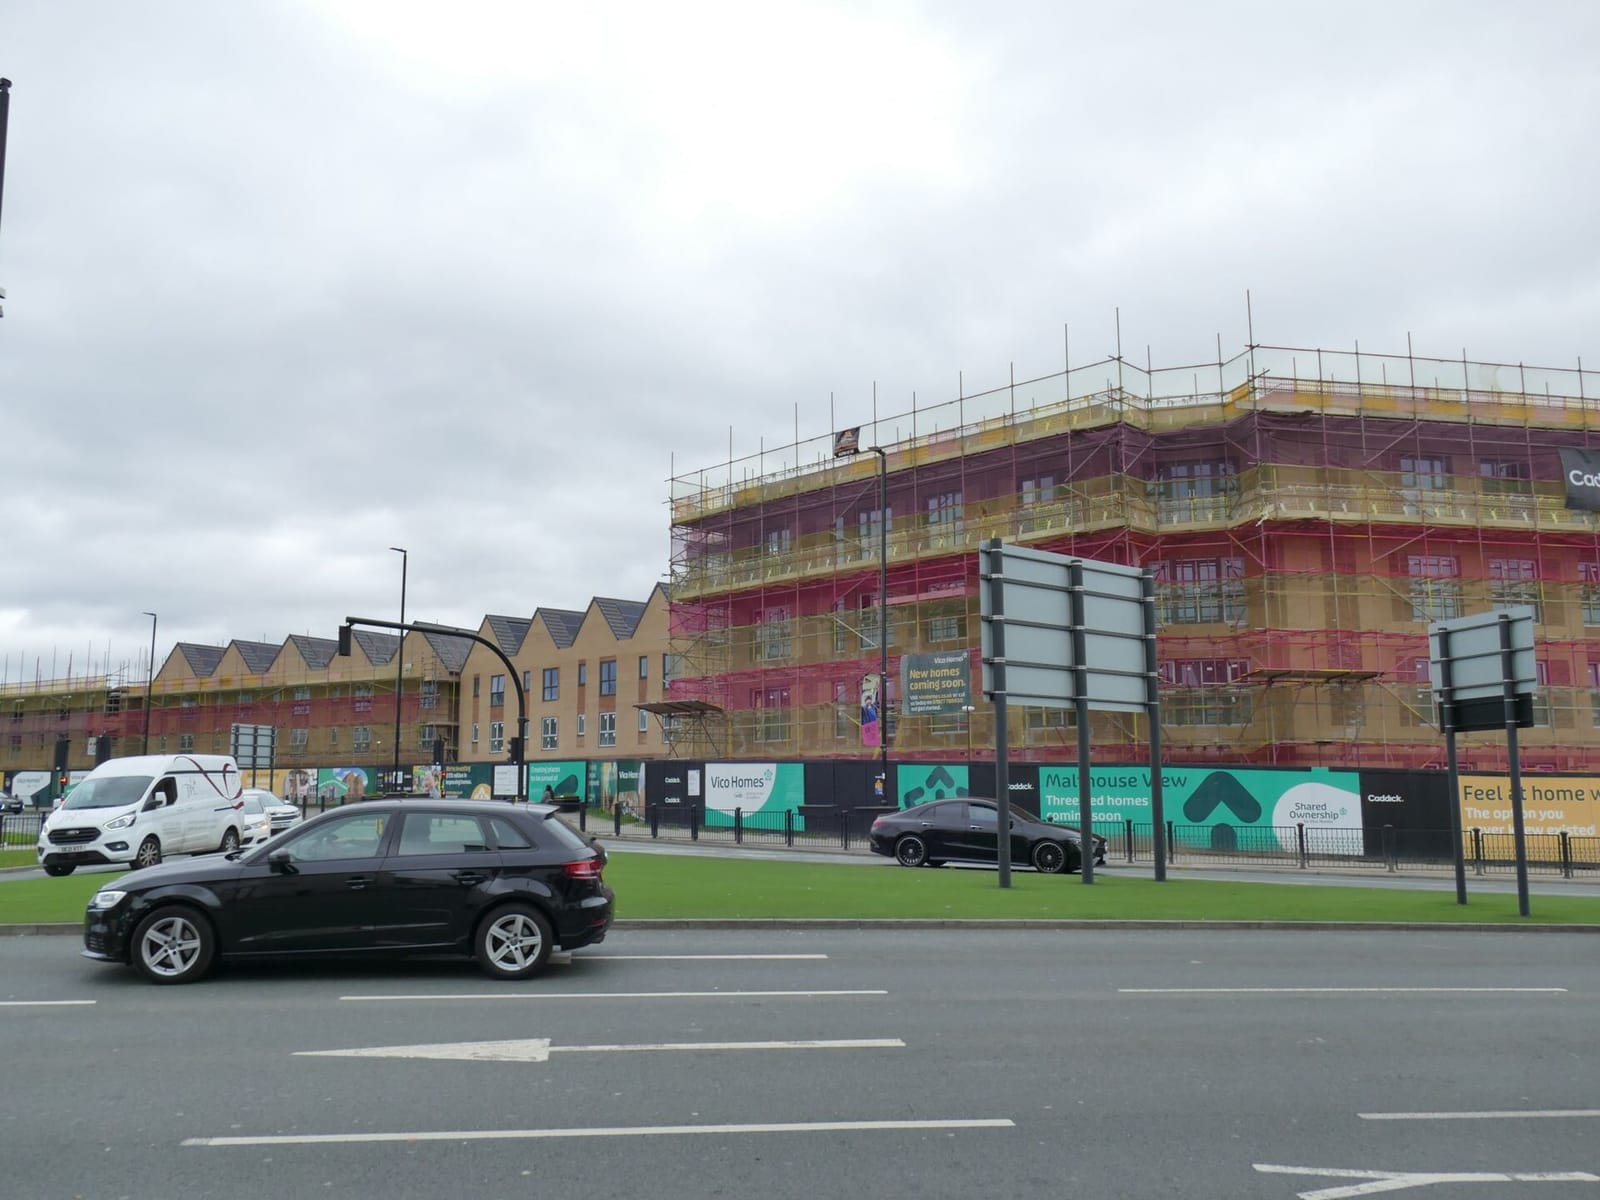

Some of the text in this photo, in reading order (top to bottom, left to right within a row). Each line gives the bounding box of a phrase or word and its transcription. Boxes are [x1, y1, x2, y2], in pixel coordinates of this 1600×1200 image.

[910, 667, 960, 679] New homes
[910, 679, 940, 691] coming
[711, 776, 730, 788] Vico
[732, 776, 764, 788] Homes
[1142, 773, 1187, 788] Vew
[1464, 785, 1503, 800] Feel
[1532, 785, 1585, 801] home
[1107, 795, 1148, 806] homes
[1295, 802, 1327, 811] Shared
[1047, 810, 1121, 821] comin soon
[1290, 810, 1339, 820] Ownership
[1464, 807, 1564, 821] The opton you
